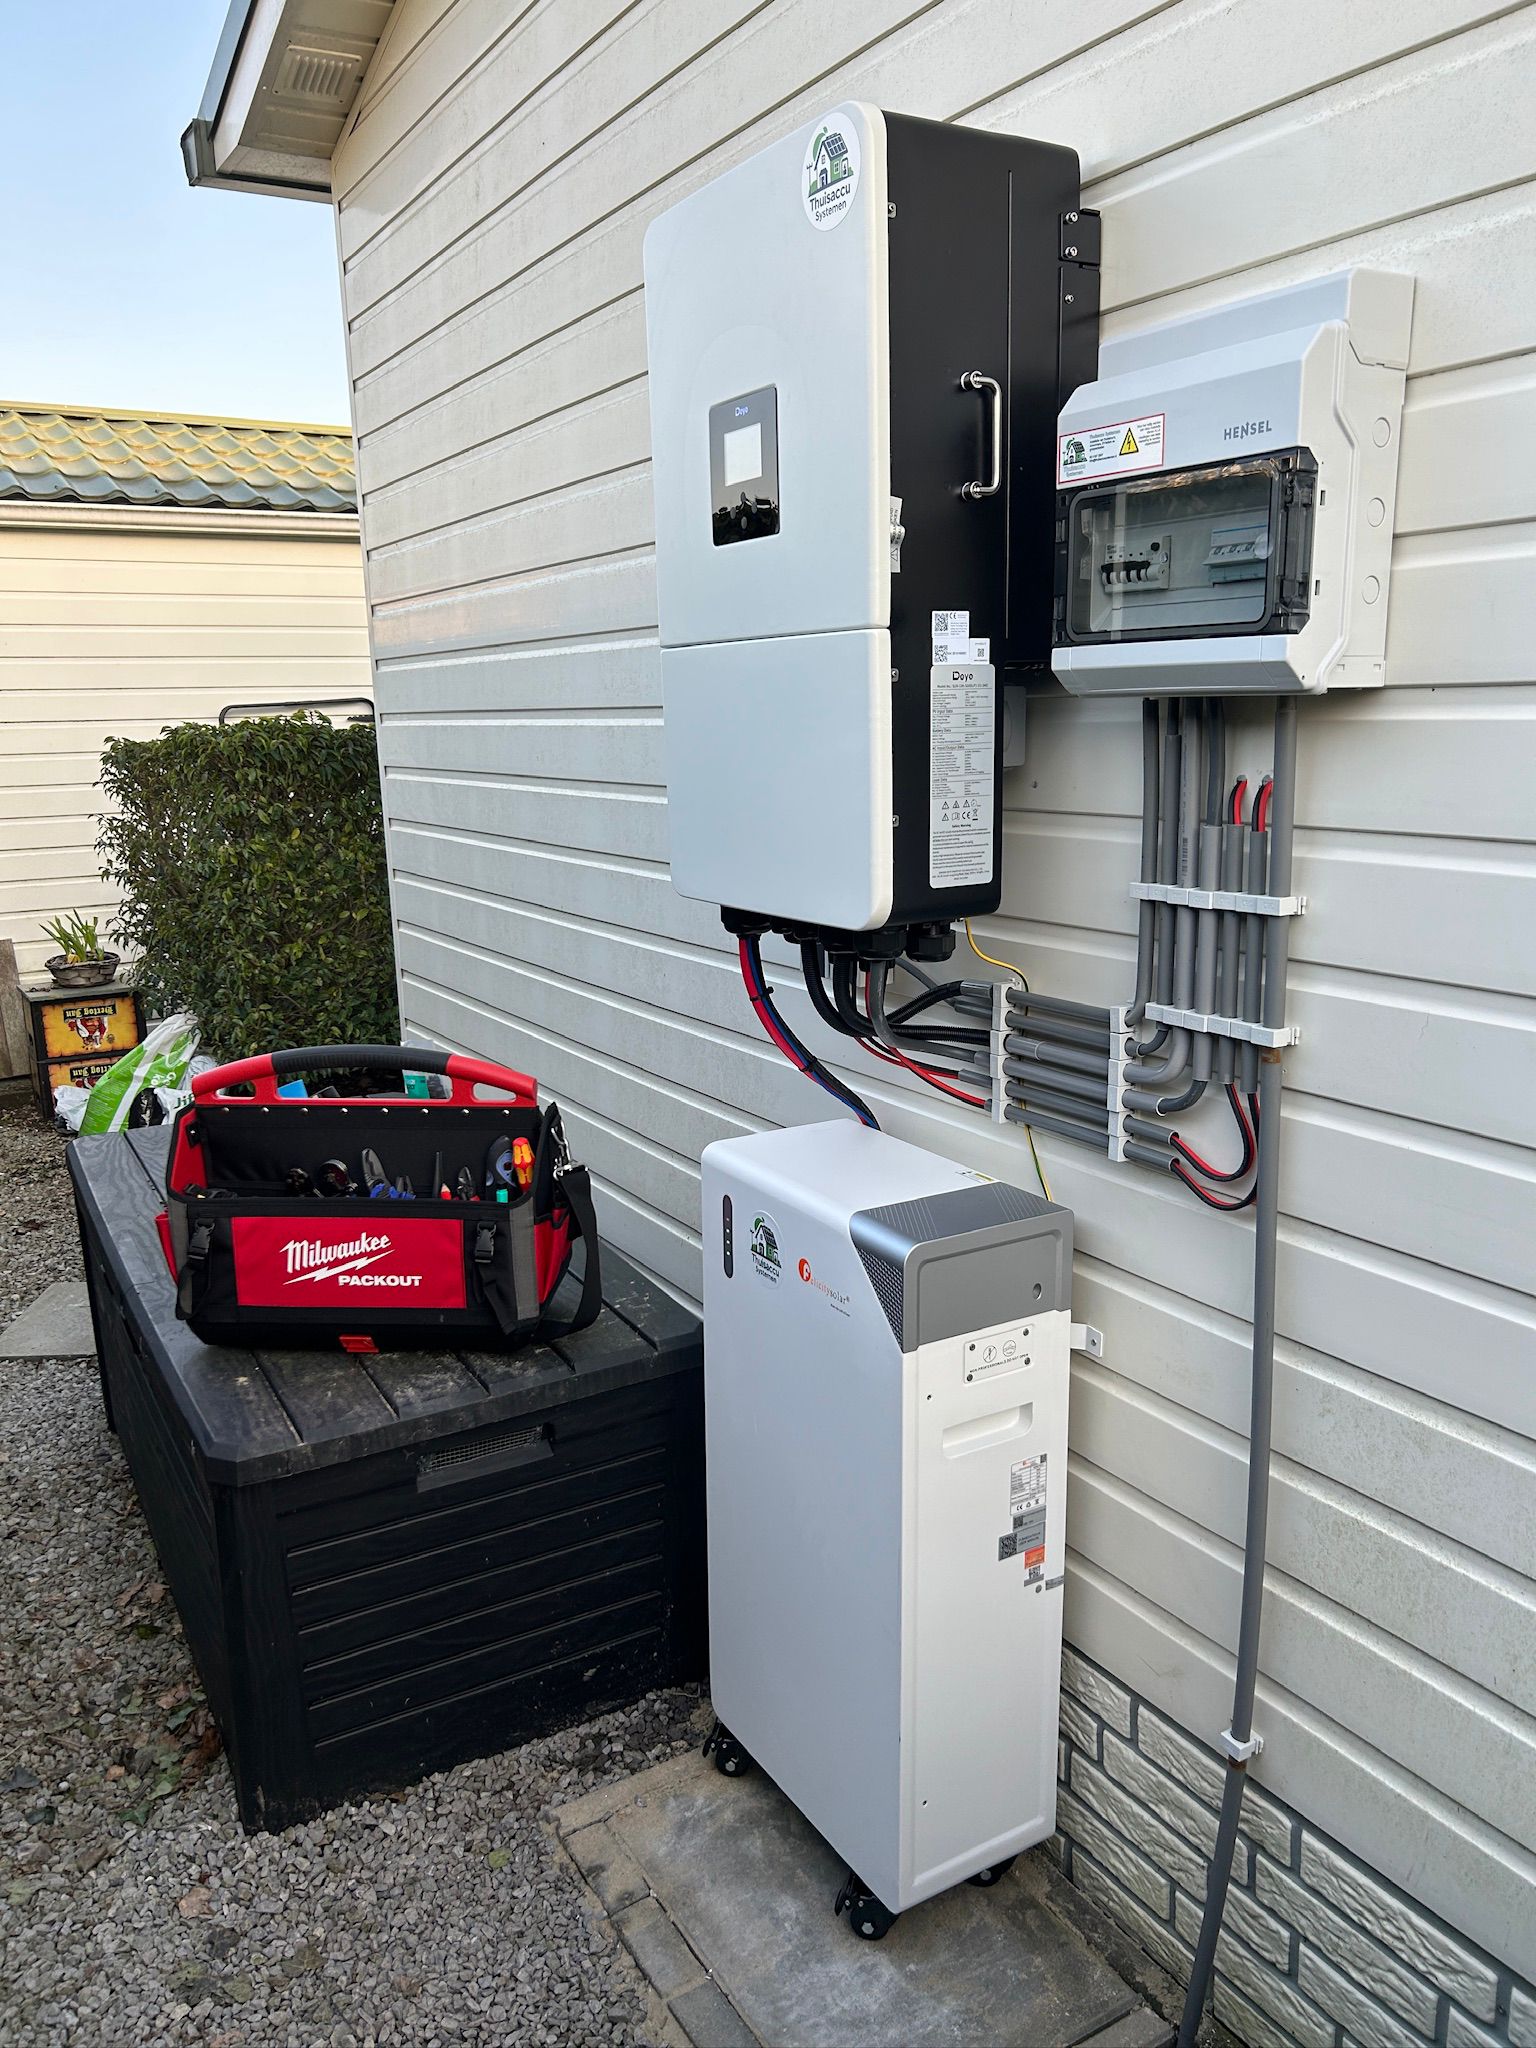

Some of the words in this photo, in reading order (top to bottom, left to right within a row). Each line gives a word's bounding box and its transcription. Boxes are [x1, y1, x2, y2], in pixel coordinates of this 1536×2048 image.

[809, 183, 851, 212] Thuisaccu
[815, 200, 847, 222] Systemen
[1223, 419, 1273, 441] HENSEL
[66, 1008, 83, 1018] Jan
[84, 1006, 114, 1016] Hertog
[73, 1067, 89, 1077] Jan
[279, 1231, 393, 1274] Milwaukee
[338, 1274, 423, 1287] PACKOUT
